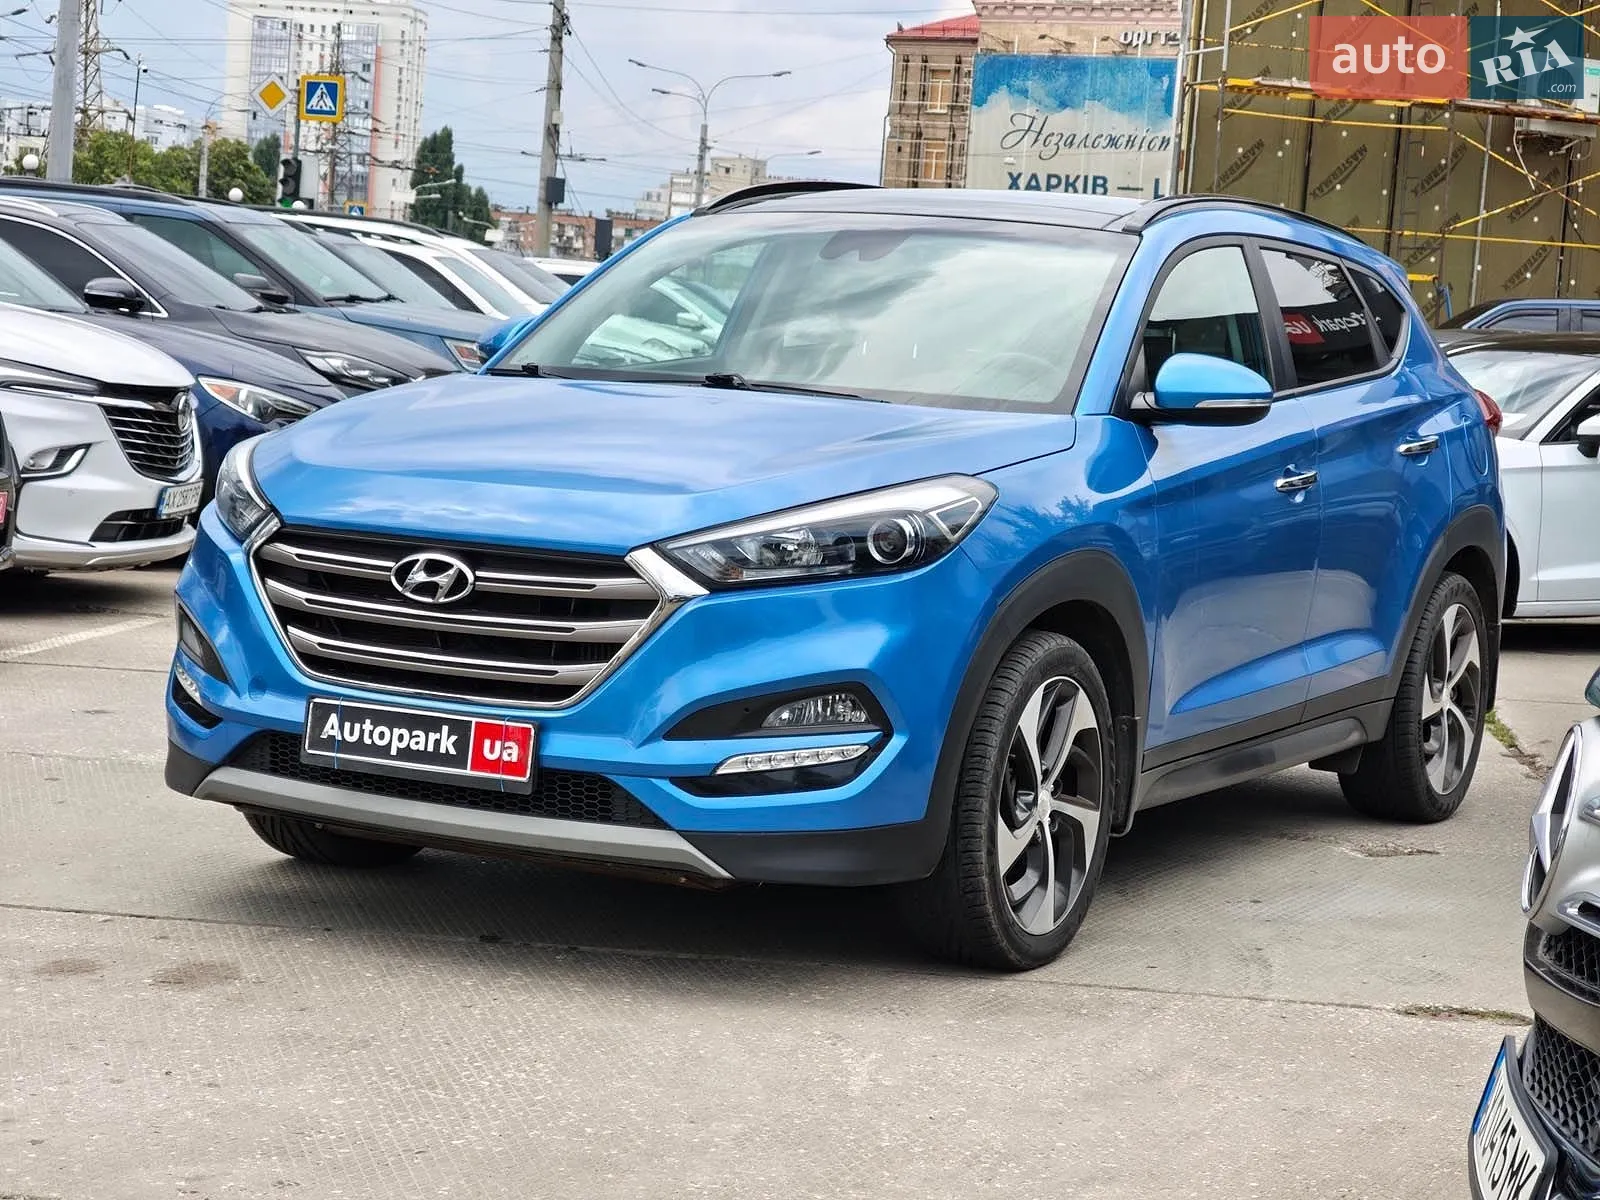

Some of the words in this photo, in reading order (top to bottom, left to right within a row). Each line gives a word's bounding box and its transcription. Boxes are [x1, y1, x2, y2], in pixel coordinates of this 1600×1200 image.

[1007, 171, 1109, 196] ХАРКІВ
[1310, 143, 1368, 199] MASTERMAX
[320, 713, 458, 756] Autopark
[483, 737, 519, 763] ua
